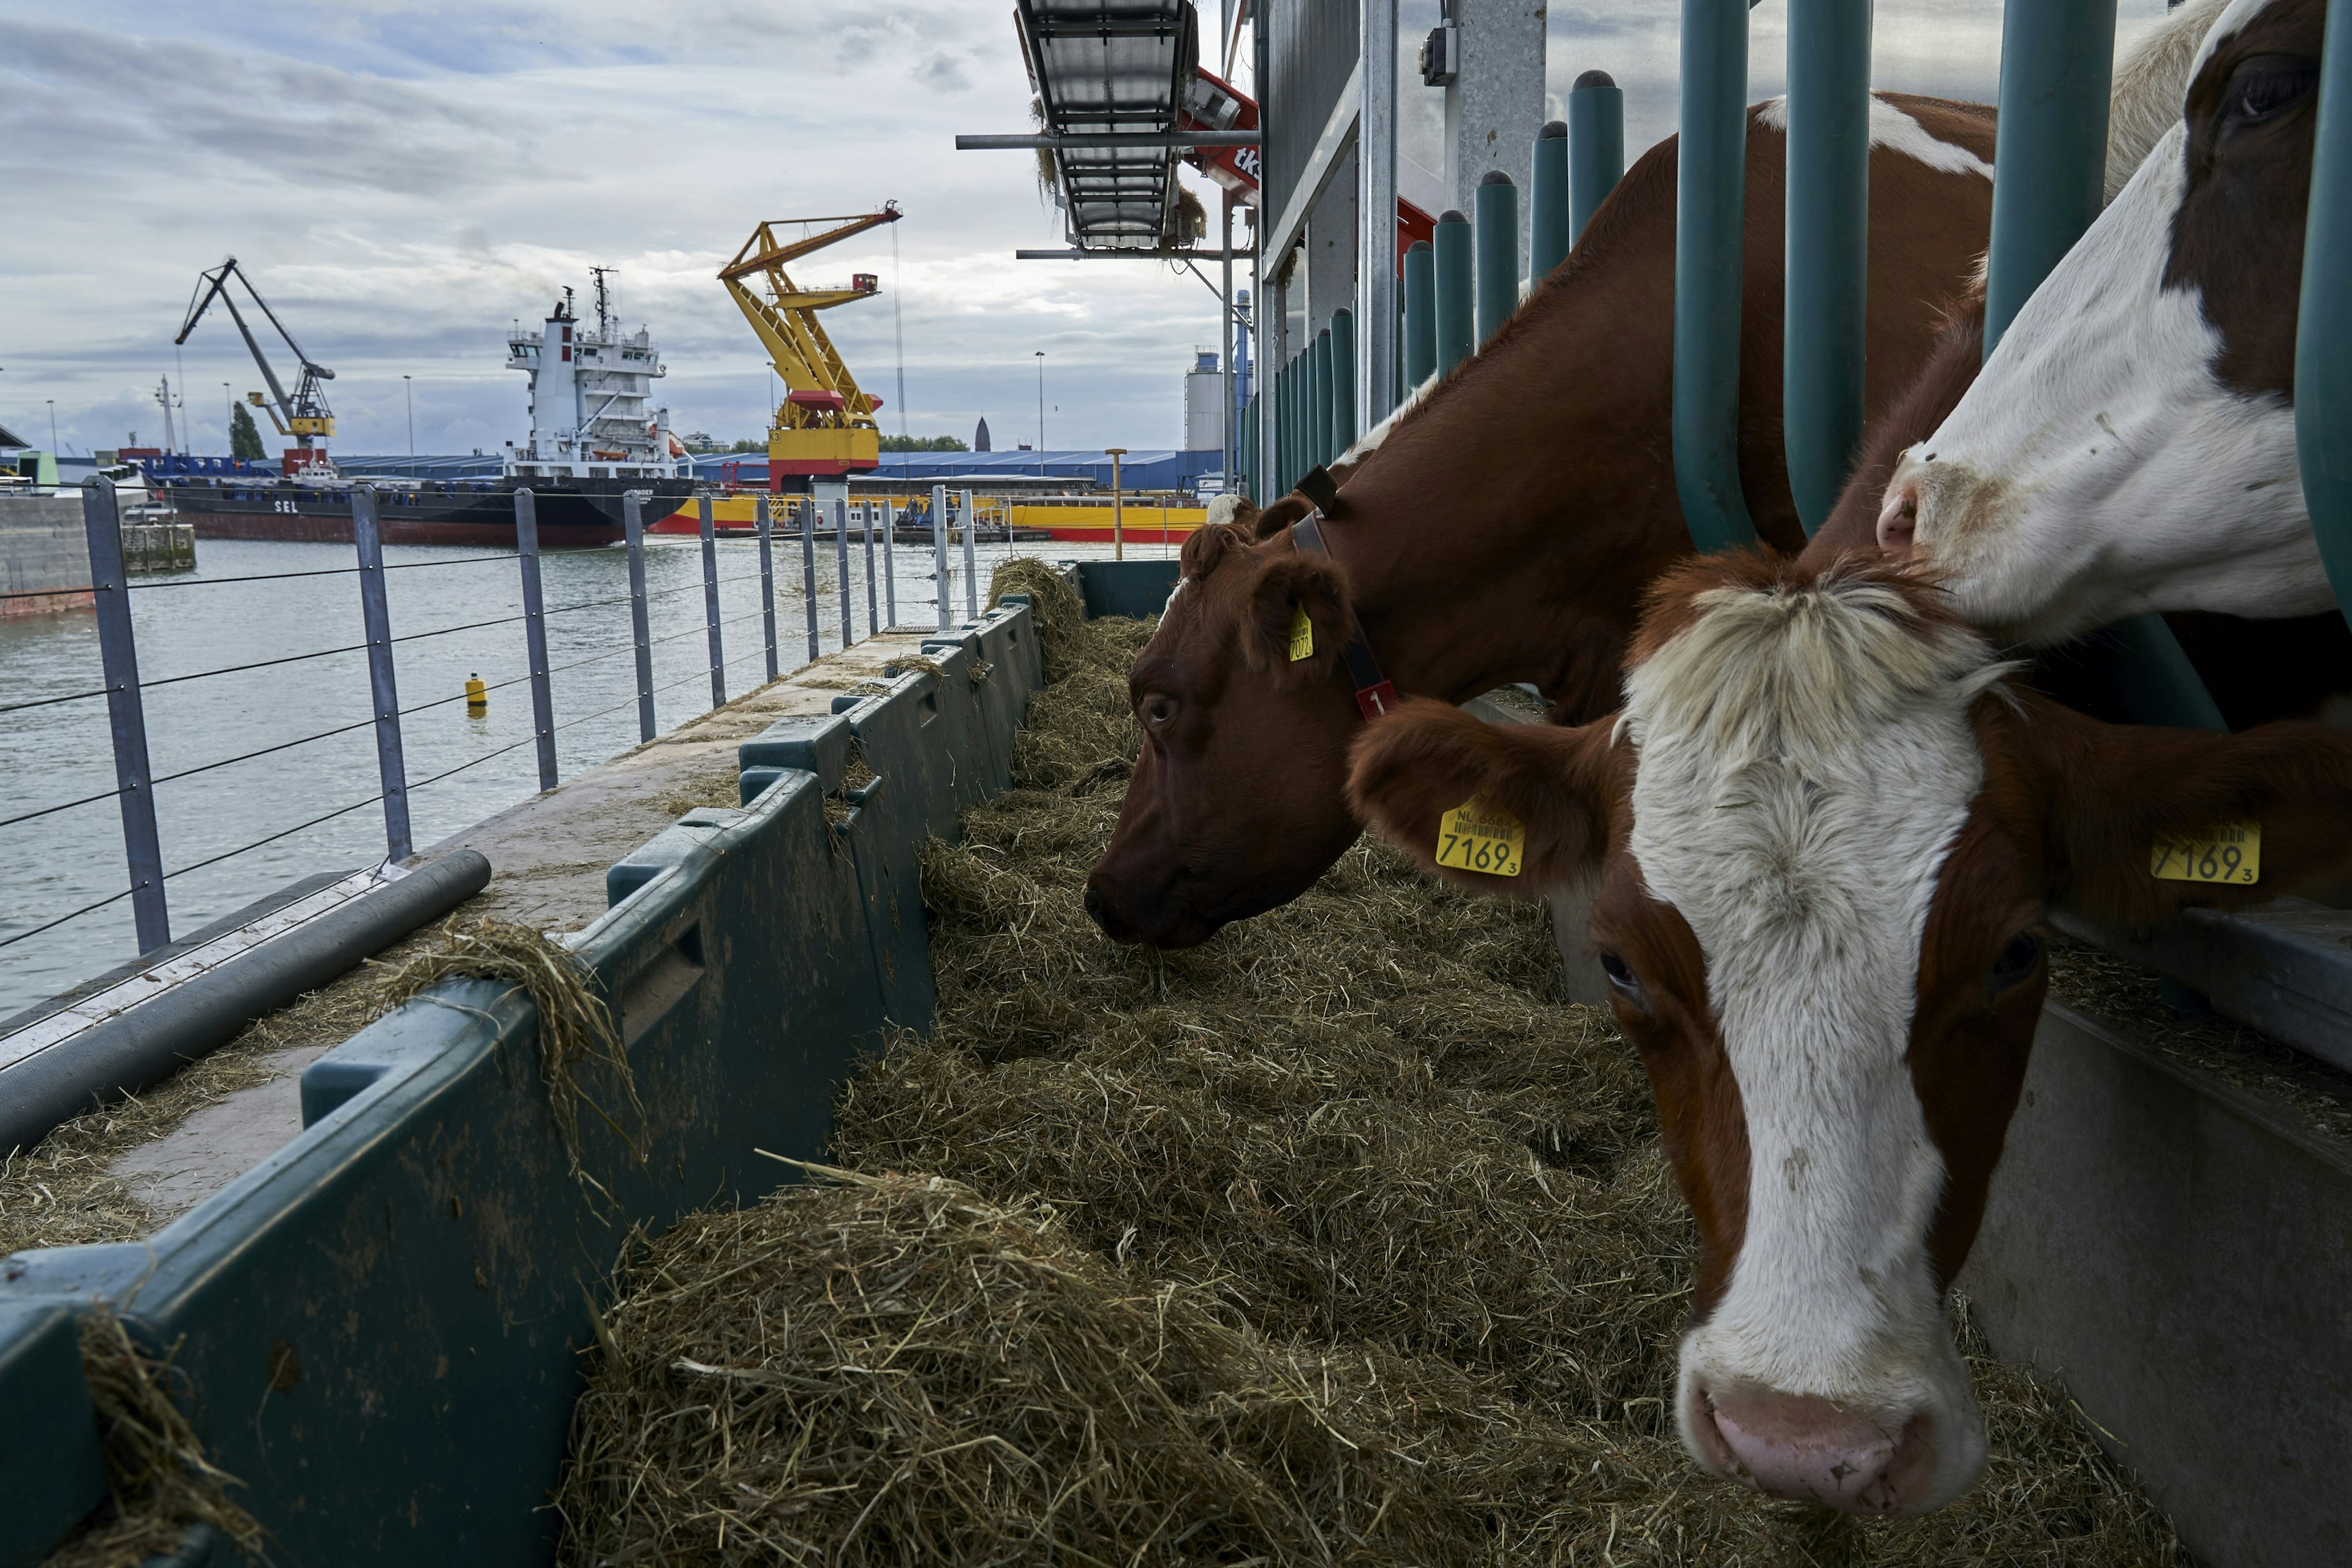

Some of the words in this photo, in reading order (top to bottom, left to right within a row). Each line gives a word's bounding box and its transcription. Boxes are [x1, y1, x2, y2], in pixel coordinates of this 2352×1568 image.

[769, 432, 780, 442] K3
[274, 500, 298, 513] SEL
[1291, 635, 1309, 660] 7072
[1457, 810, 1473, 823] NL
[1439, 833, 1510, 872] 7169
[2154, 839, 2242, 880] 7169
